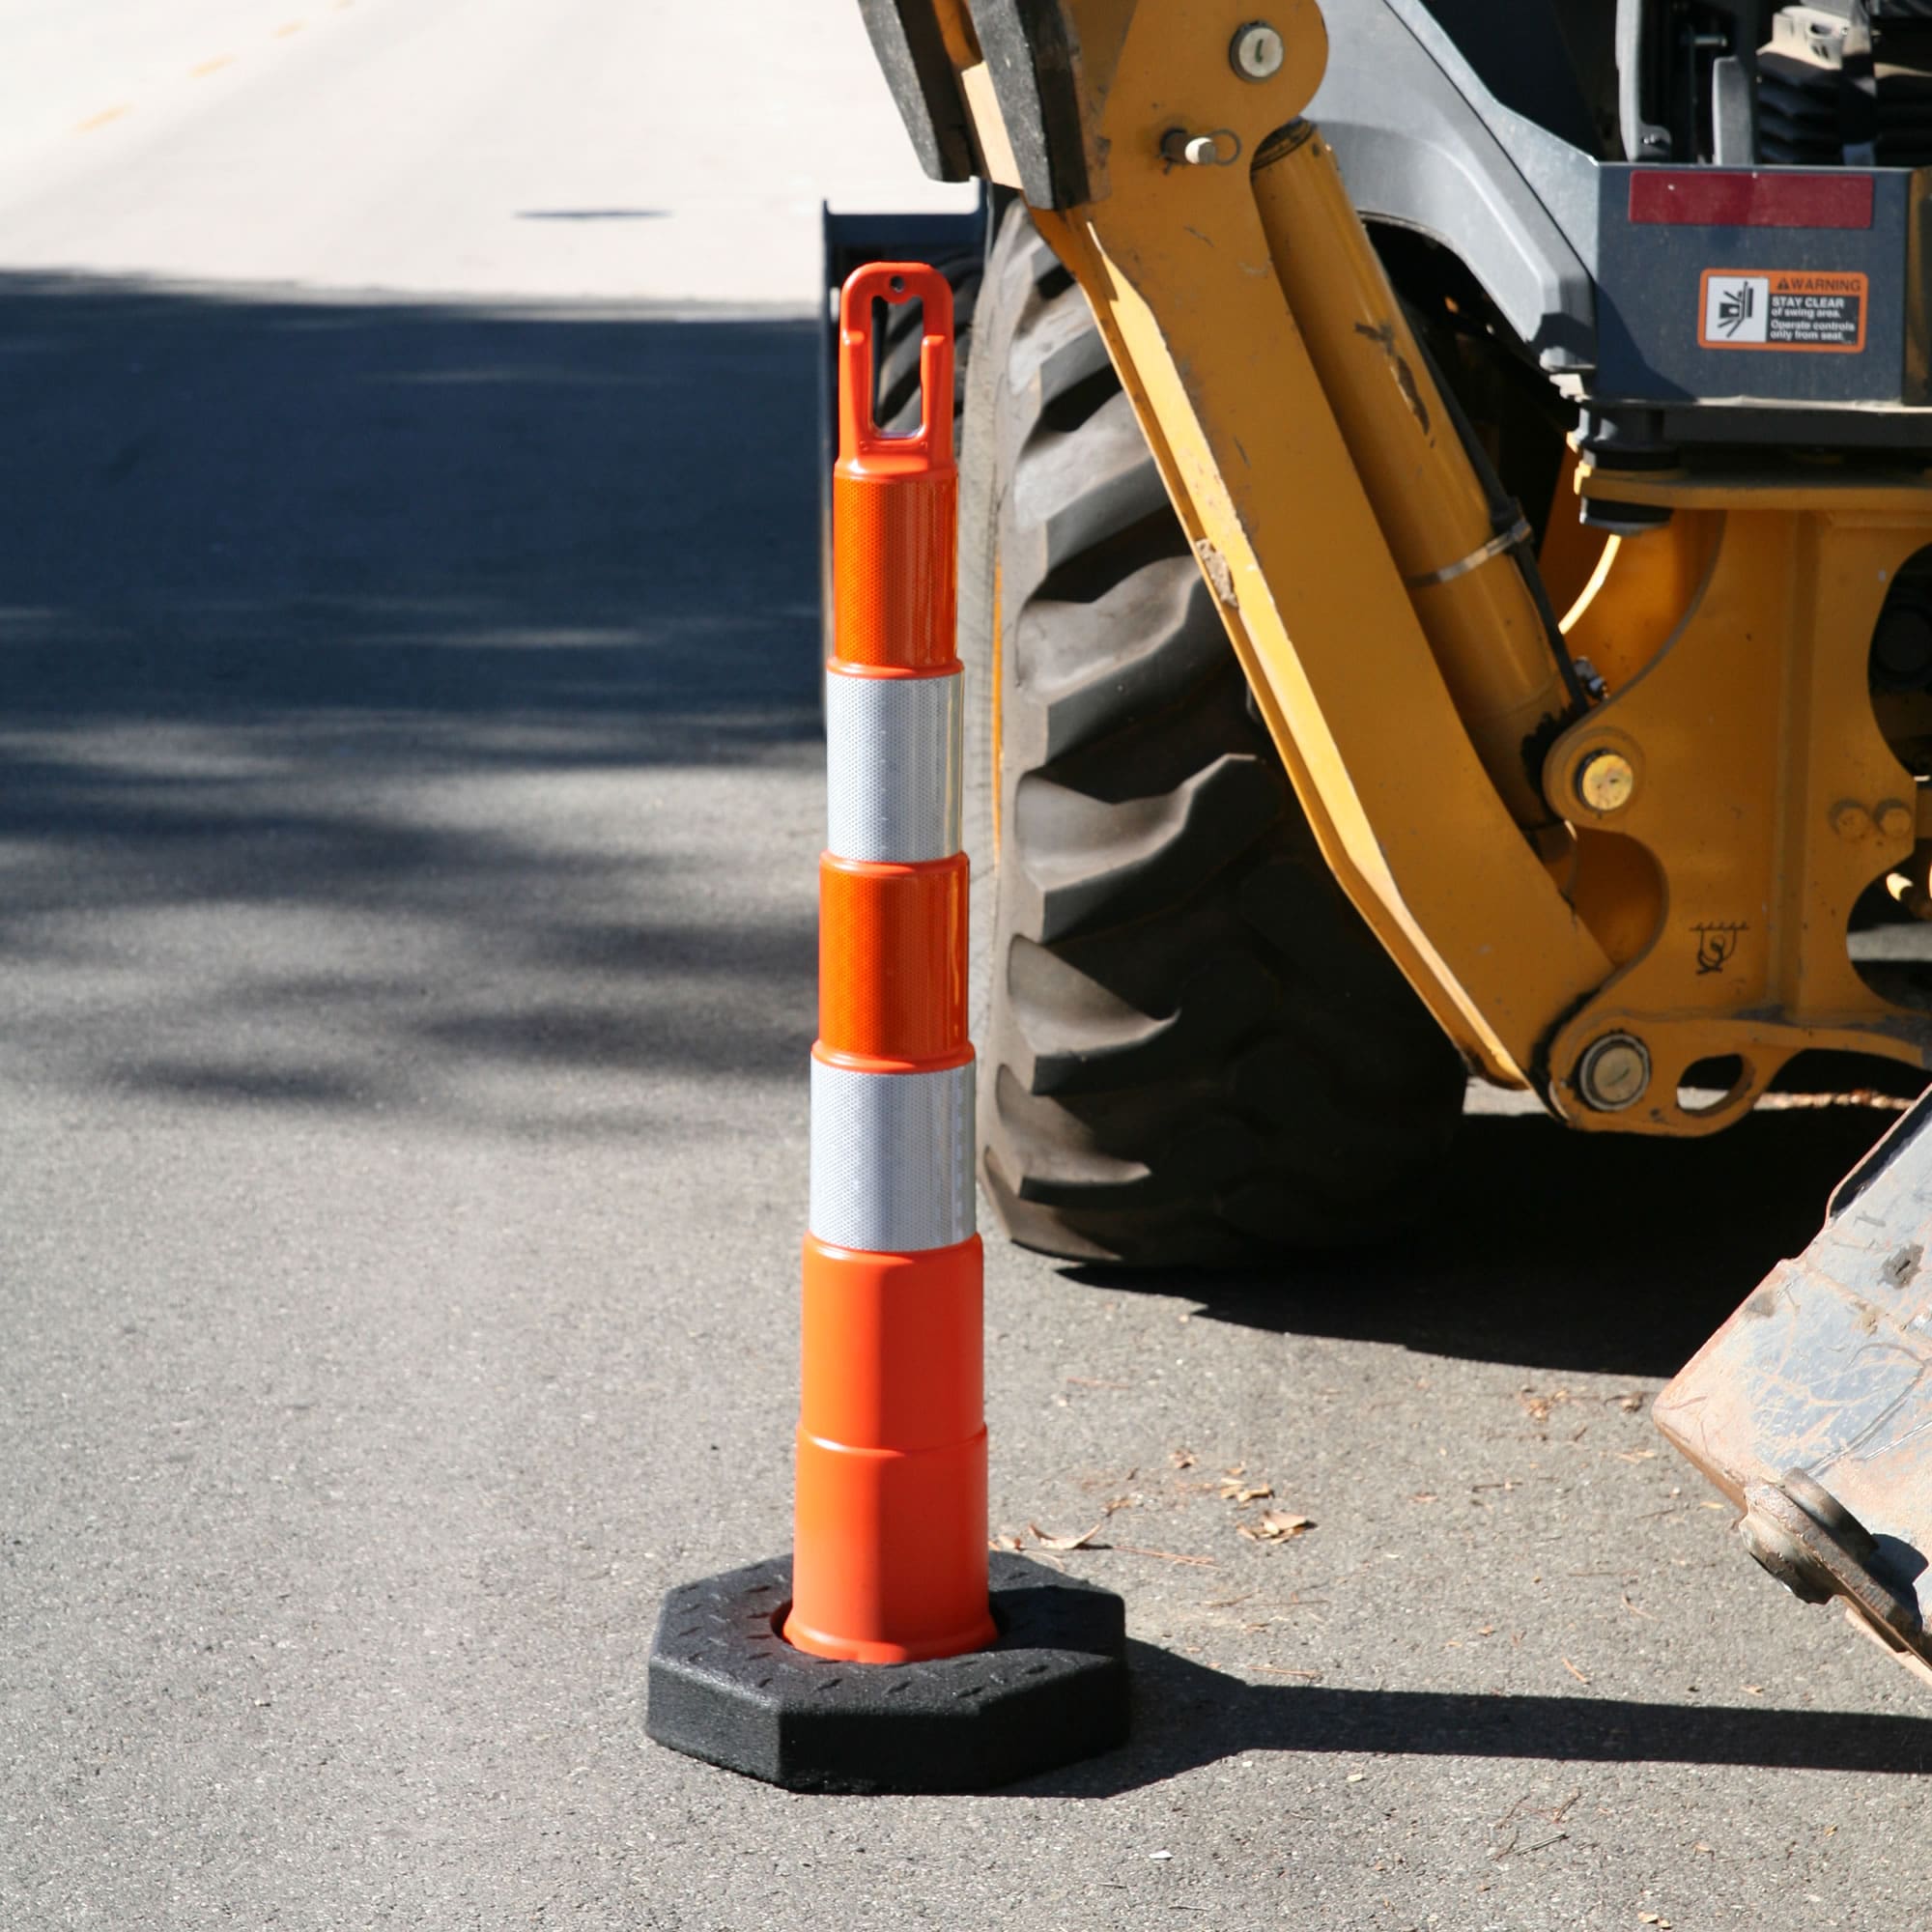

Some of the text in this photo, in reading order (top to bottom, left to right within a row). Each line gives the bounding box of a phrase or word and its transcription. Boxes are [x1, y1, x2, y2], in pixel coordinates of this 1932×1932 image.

[1791, 278, 1861, 293] WARNING
[1772, 297, 1844, 308] STAY CLEAR
[1771, 307, 1841, 319] of swing area.
[1771, 320, 1855, 331] Operate controls
[1770, 329, 1844, 340] only from seat.
